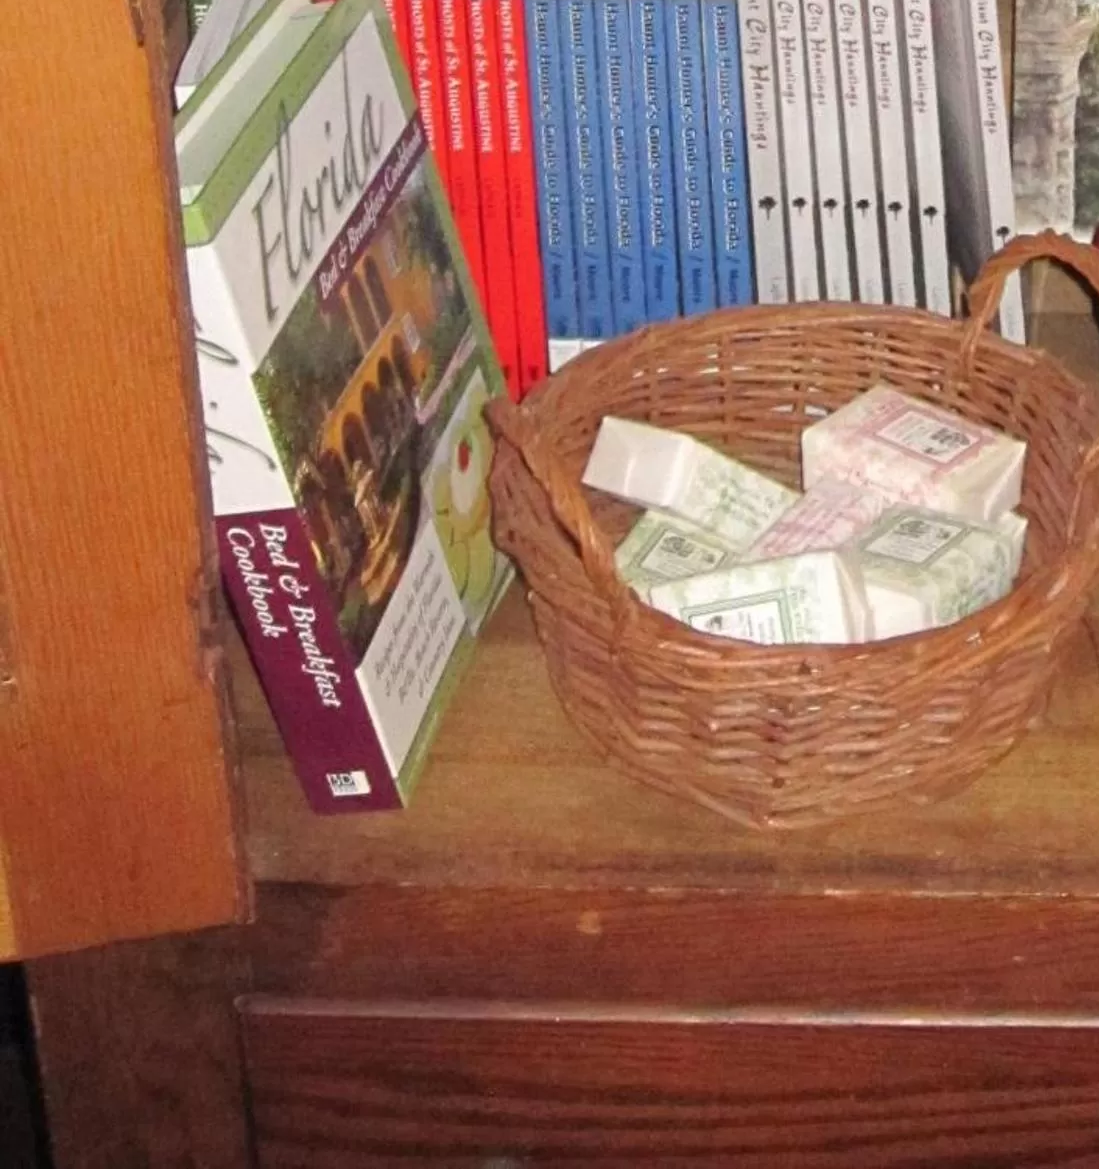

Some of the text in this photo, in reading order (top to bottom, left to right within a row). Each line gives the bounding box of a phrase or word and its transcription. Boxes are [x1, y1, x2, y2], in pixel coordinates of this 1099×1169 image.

[534, 2, 548, 50] Haunt
[604, 2, 618, 50] Haunt
[640, 2, 655, 50] Haunt
[713, 5, 728, 53] Haunt
[745, 18, 767, 56] City
[749, 66, 770, 150] Hauntings
[252, 46, 384, 324] Florida
[319, 254, 338, 300] Bed
[347, 184, 387, 254] Breakfast
[226, 526, 288, 639] Cookbook
[259, 522, 342, 709] Bed & Breakfast
